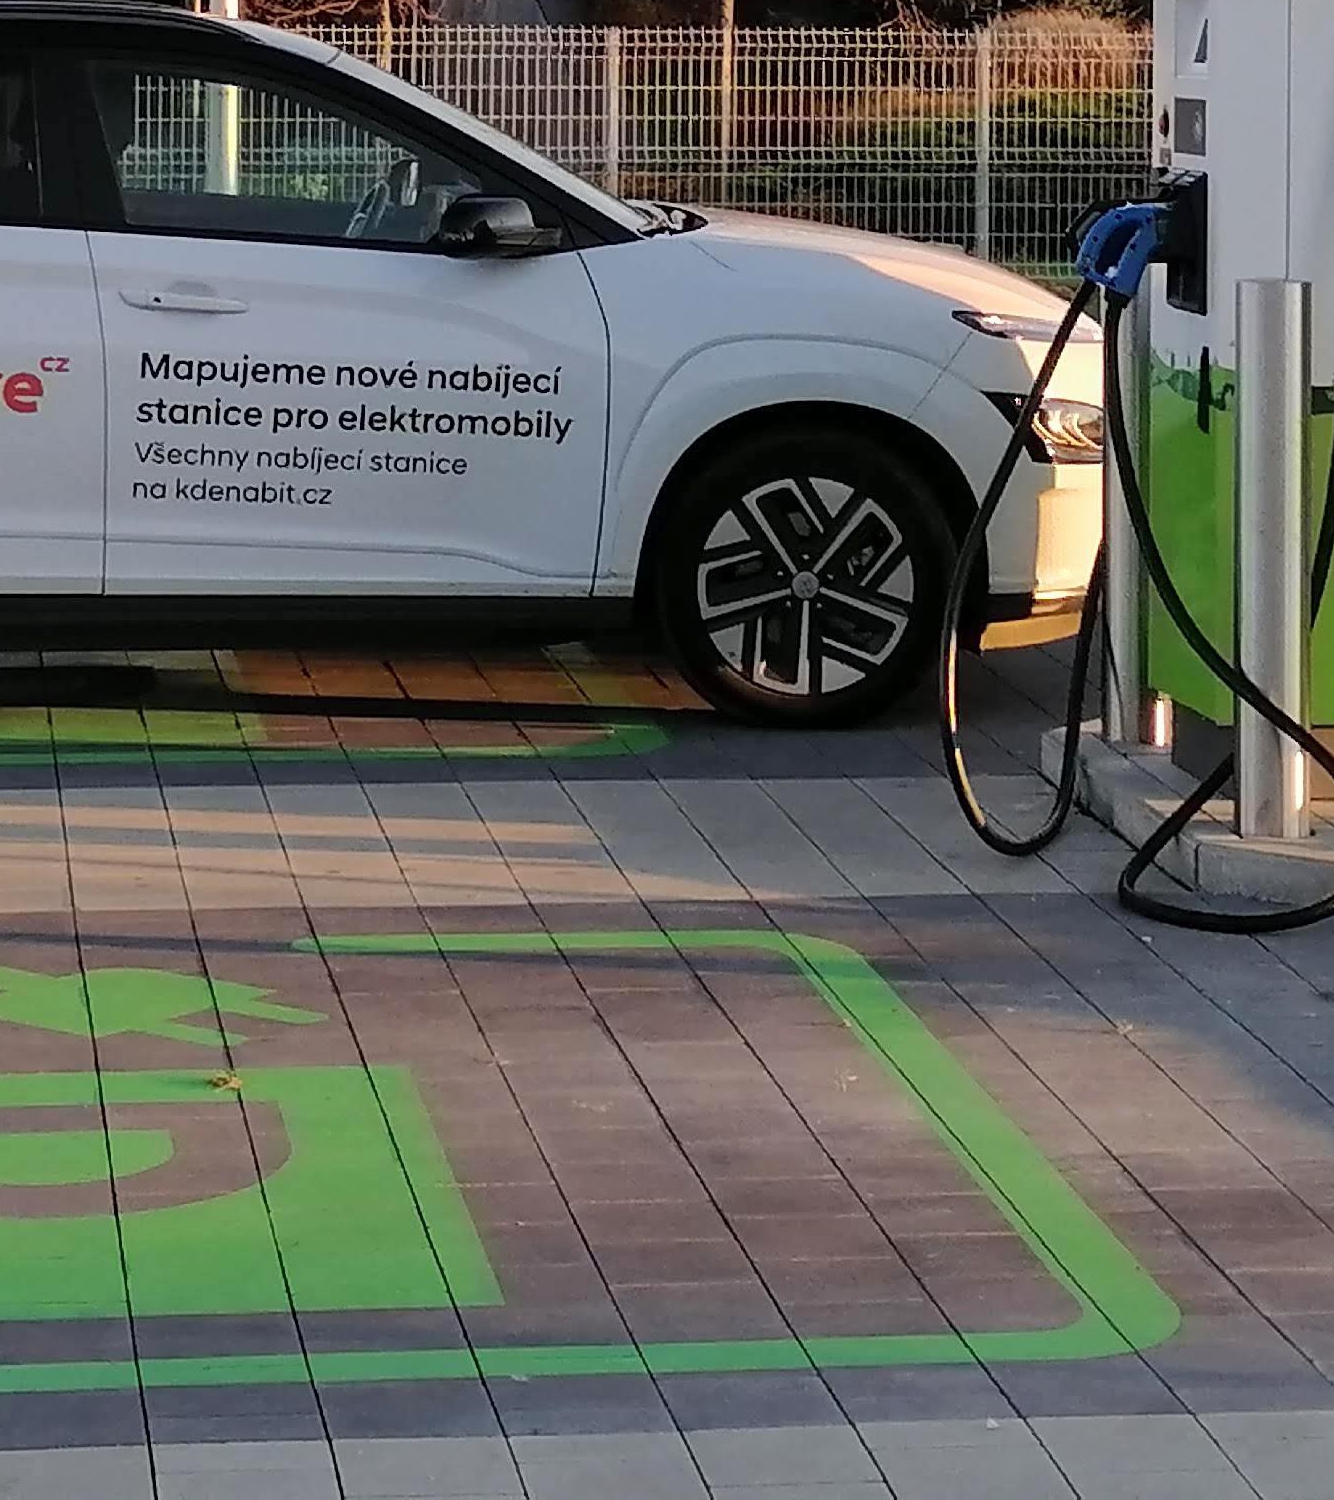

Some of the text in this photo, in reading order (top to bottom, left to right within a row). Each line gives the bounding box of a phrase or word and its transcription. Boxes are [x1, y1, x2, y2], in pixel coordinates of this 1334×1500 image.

[140, 352, 562, 398] Mapujeme nové nabíjecí
[136, 398, 573, 445] stanice pro elektromobily
[134, 442, 468, 475] Všechny nabíjecí stanice
[132, 480, 333, 505] na kdenabit.cz
